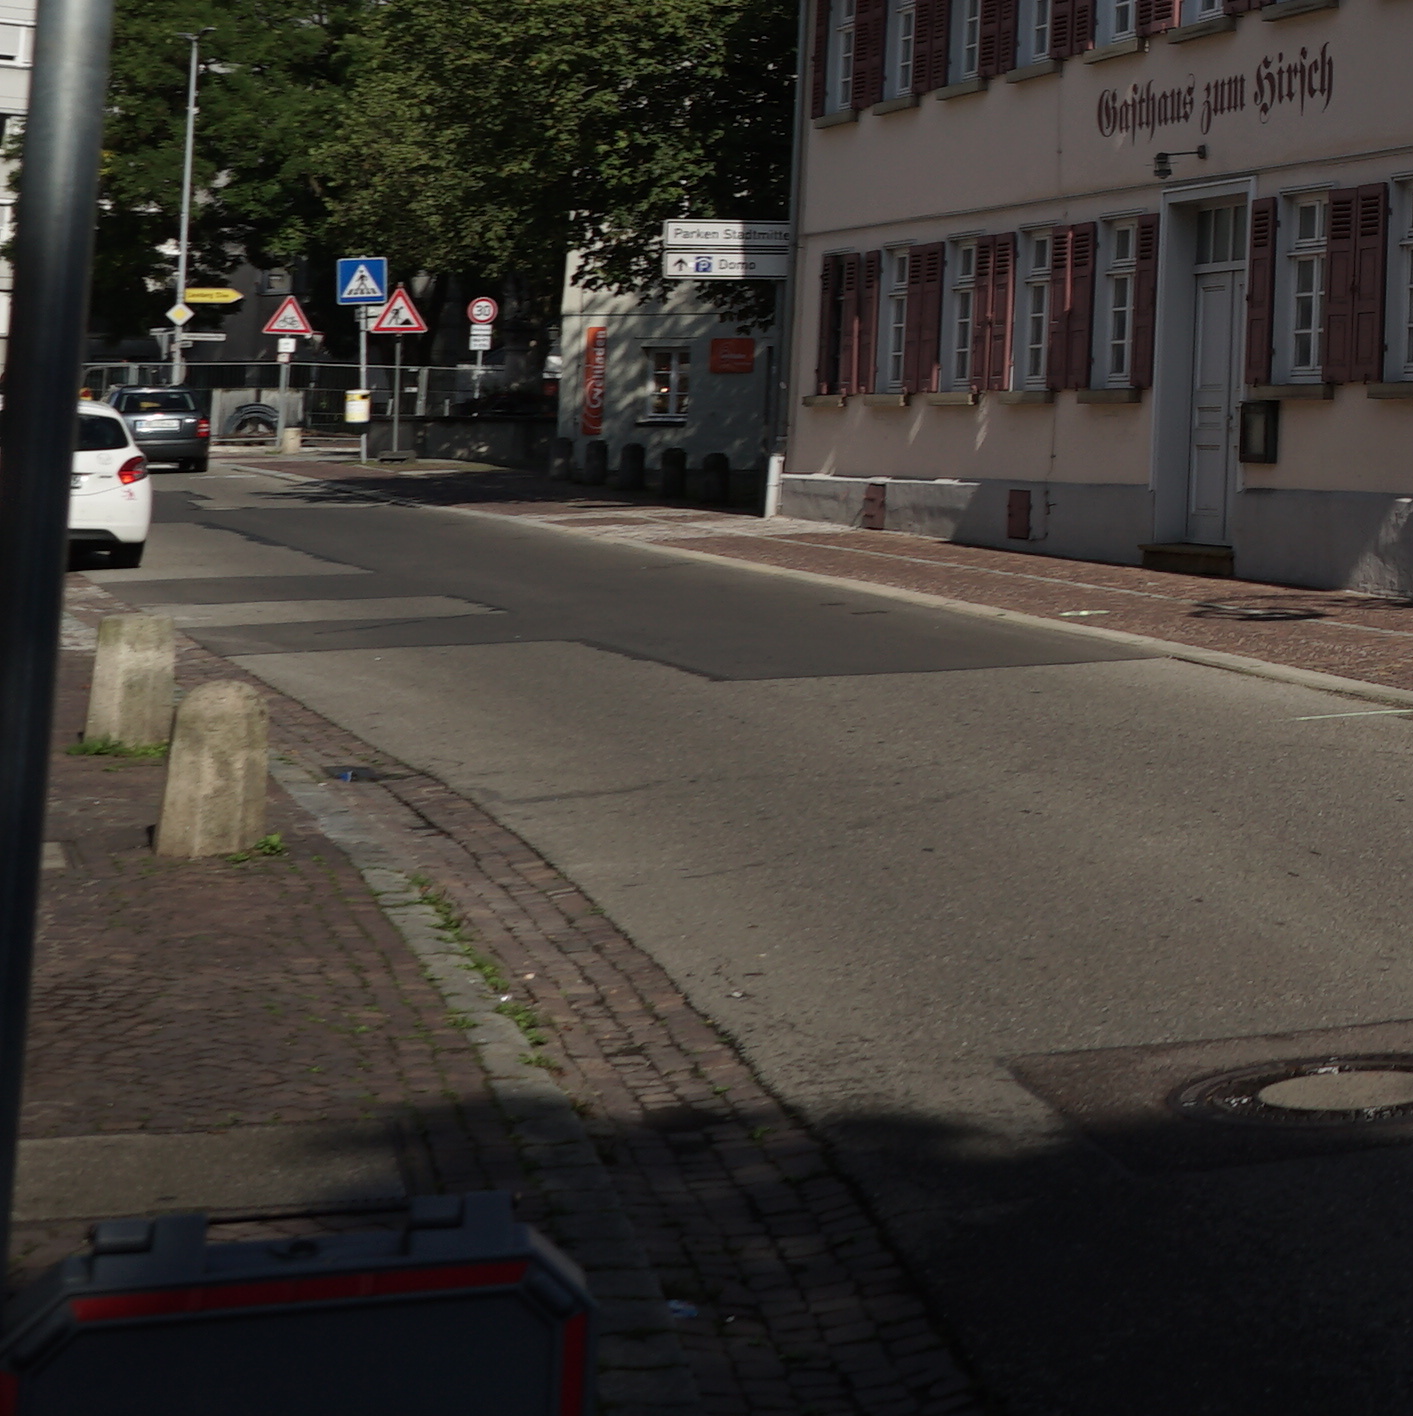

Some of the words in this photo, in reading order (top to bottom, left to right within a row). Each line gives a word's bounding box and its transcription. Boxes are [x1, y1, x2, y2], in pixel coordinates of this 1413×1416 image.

[1201, 74, 1247, 135] zum
[674, 228, 719, 240] Parken
[723, 229, 790, 241] Stadtmitte
[718, 259, 756, 270] Domo
[474, 305, 491, 316] 30
